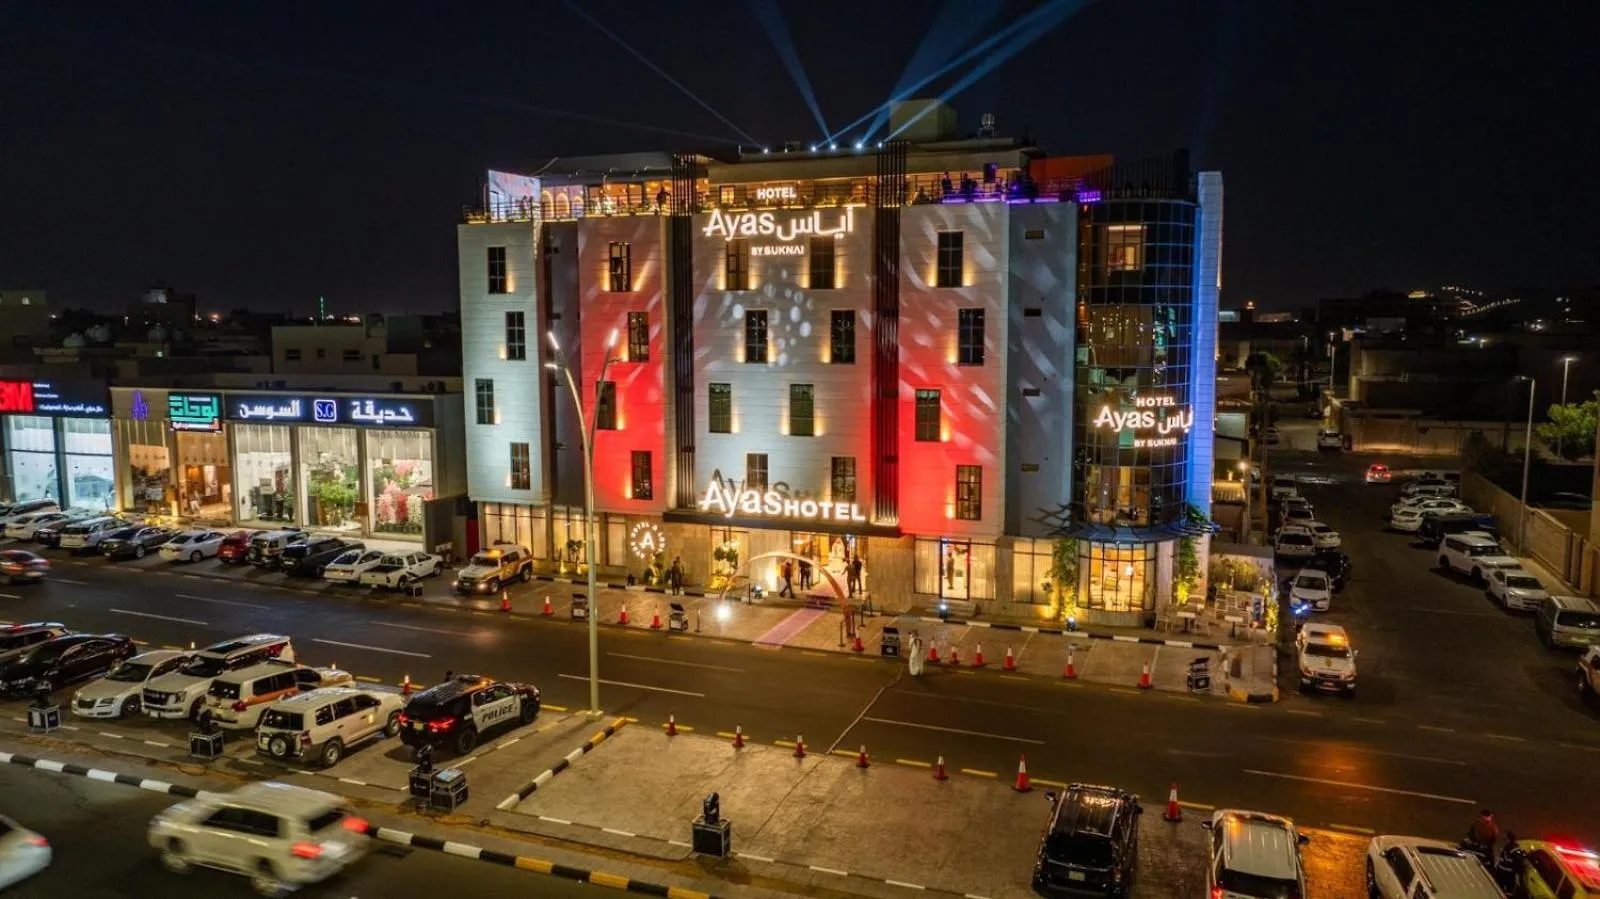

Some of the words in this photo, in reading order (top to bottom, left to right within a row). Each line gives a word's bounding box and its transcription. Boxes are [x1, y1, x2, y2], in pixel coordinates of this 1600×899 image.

[757, 187, 797, 200] HOTEL
[702, 208, 775, 241] Ayas
[751, 246, 763, 256] BY
[239, 400, 300, 420] السوسن
[1136, 397, 1175, 407] HOTEL
[352, 401, 413, 424] حديقة
[1093, 405, 1155, 432] Ayas
[699, 480, 782, 517] Ayas
[784, 501, 866, 521] HOTEL
[638, 531, 655, 550] A
[482, 704, 513, 722] POLICE
